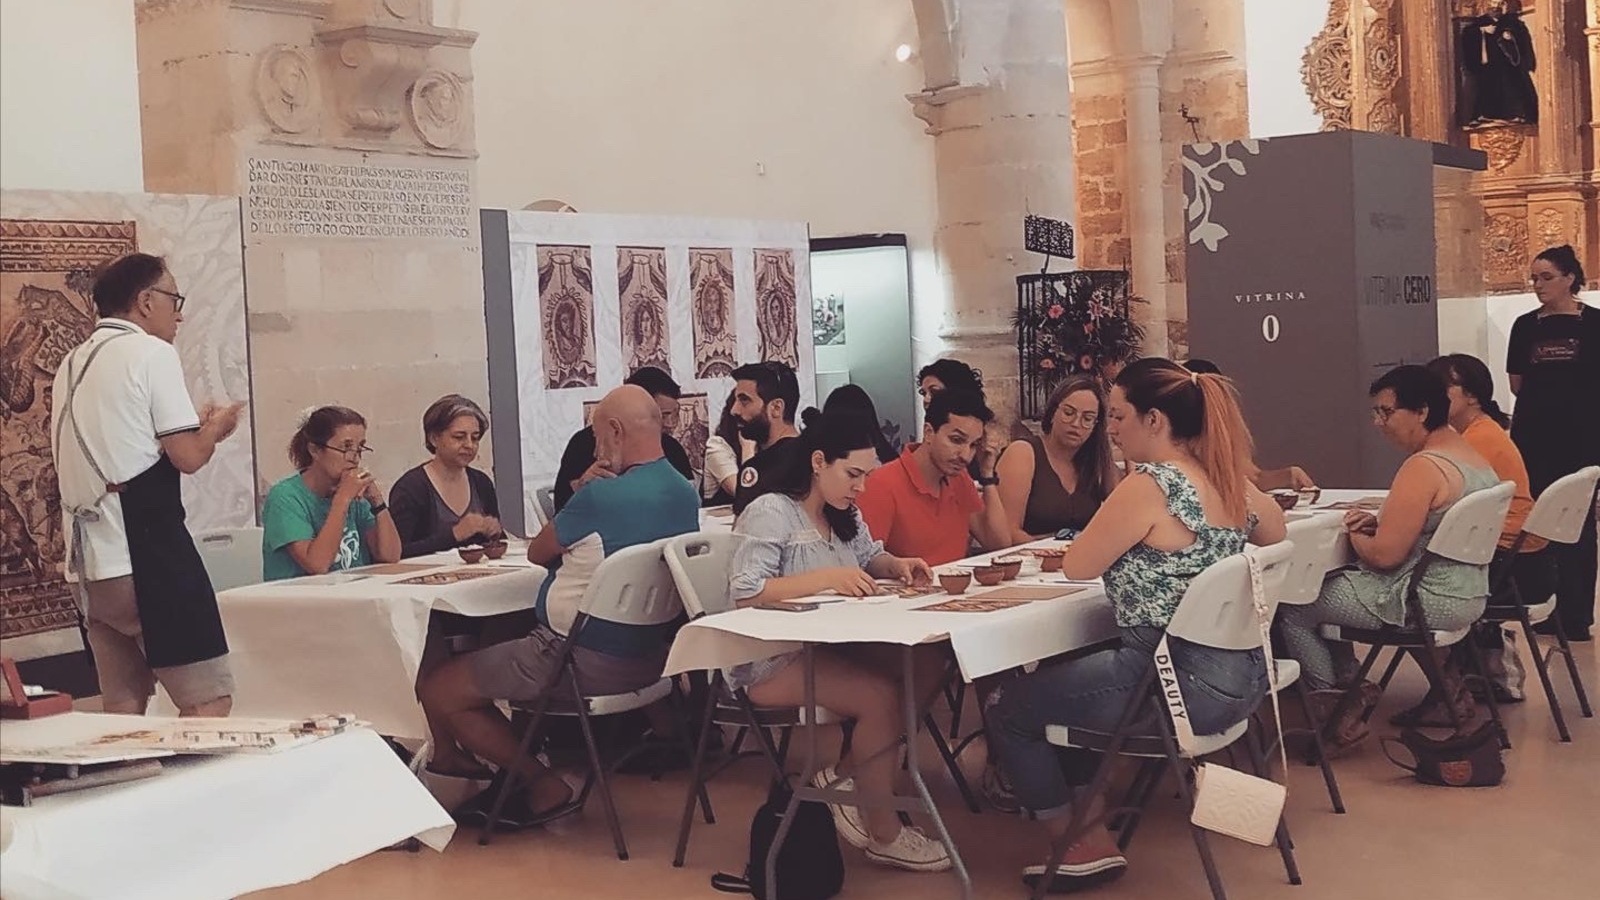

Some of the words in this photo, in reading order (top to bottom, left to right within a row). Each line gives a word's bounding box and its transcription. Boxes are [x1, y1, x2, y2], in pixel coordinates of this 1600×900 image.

[1235, 291, 1307, 303] VITRINA
[1403, 275, 1431, 304] CERO
[1262, 314, 1280, 343] 0
